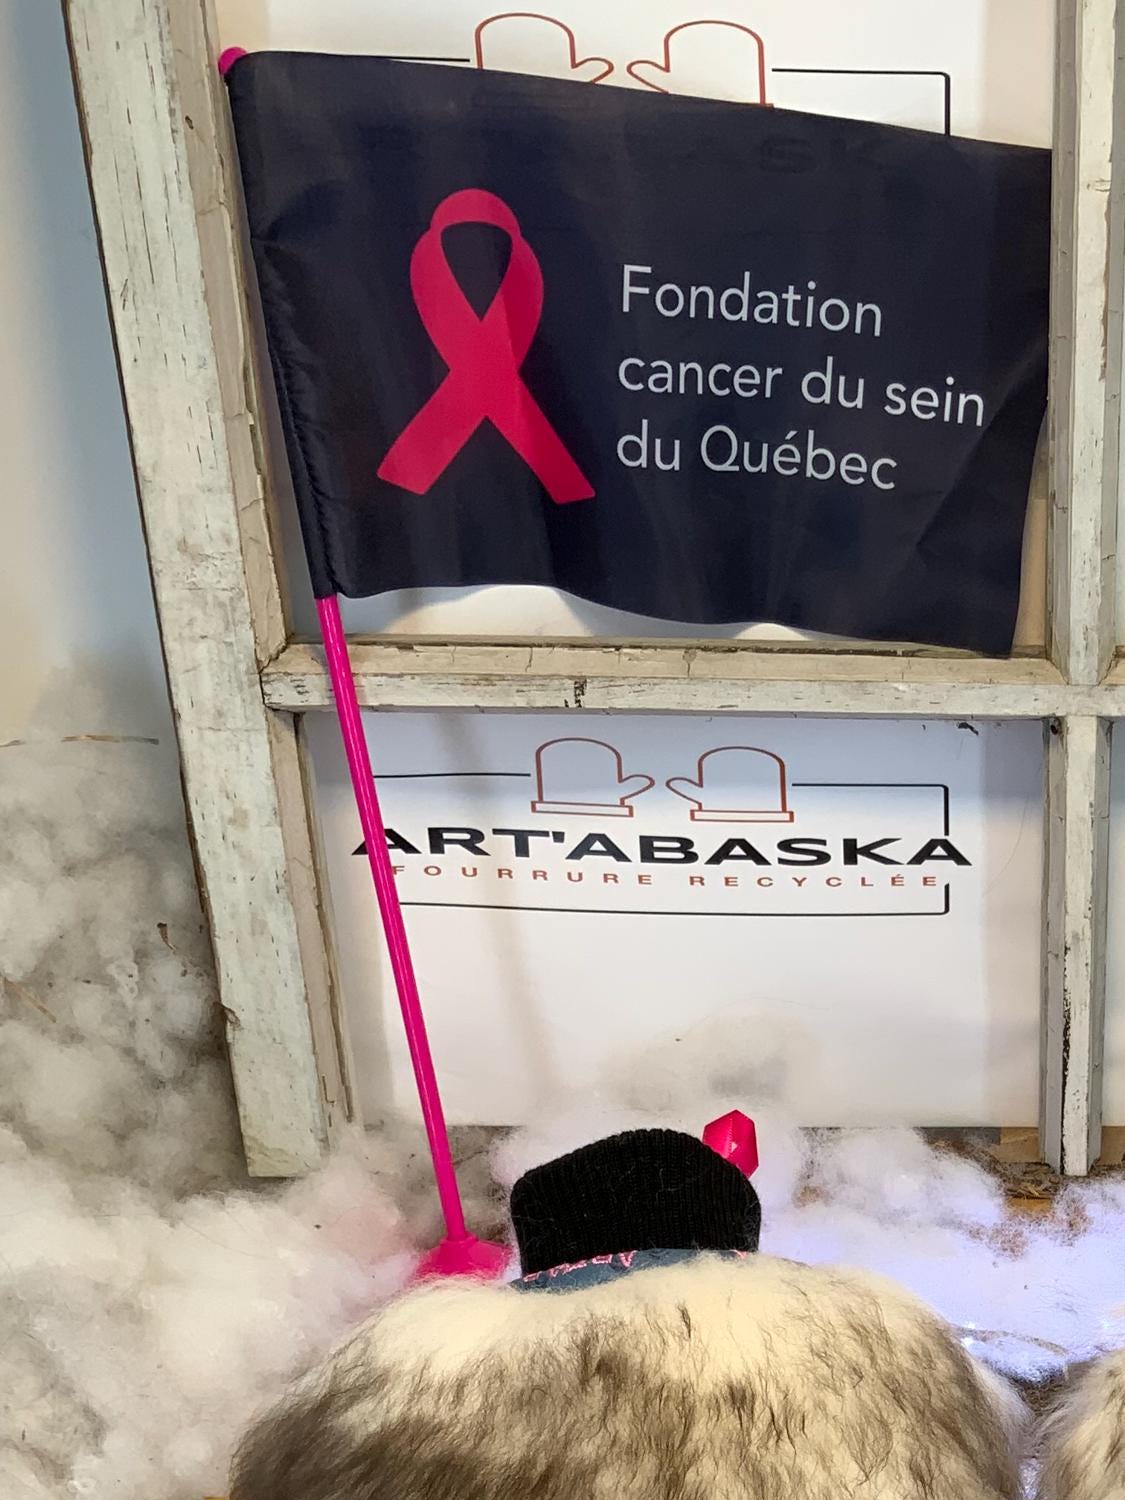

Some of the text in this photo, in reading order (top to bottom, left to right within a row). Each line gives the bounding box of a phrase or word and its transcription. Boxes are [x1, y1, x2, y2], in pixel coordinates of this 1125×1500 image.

[622, 264, 882, 337] Fondation
[618, 355, 984, 427] cancer du sein
[616, 418, 897, 490] du Québec
[351, 826, 972, 867] ART'ABASKA
[391, 864, 938, 888] FOURRURE RECYCLÉE
